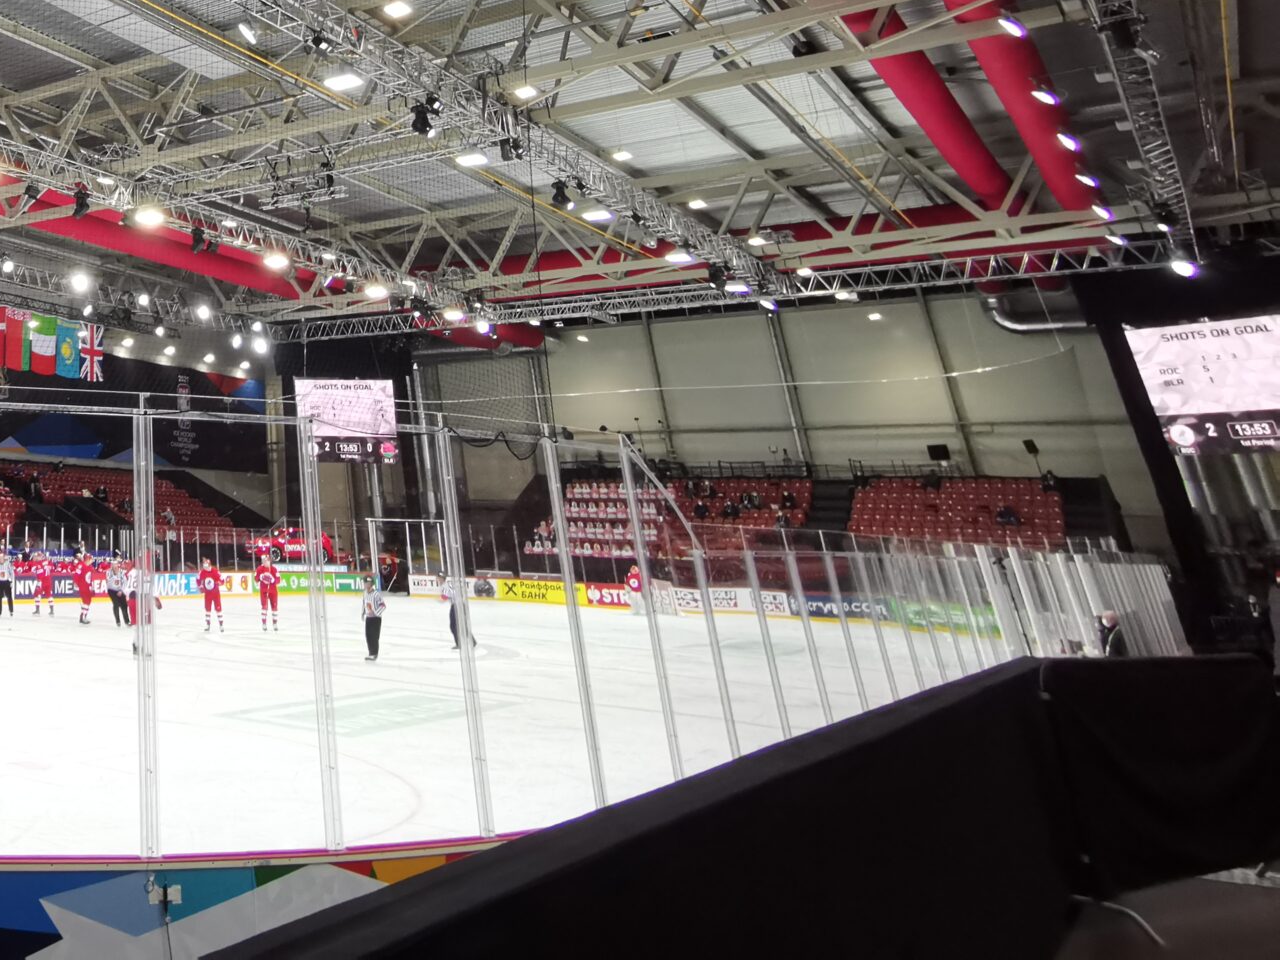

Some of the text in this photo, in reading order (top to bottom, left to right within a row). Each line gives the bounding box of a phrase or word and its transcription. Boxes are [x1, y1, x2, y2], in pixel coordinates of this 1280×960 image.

[1161, 324, 1272, 342] SHOTS ON GOAL
[1159, 367, 1181, 375] ROC
[1205, 423, 1271, 437] 2 13:53
[325, 442, 372, 452] 2 13:53 0
[153, 573, 188, 596] Wolt
[521, 591, 547, 600] БАНК
